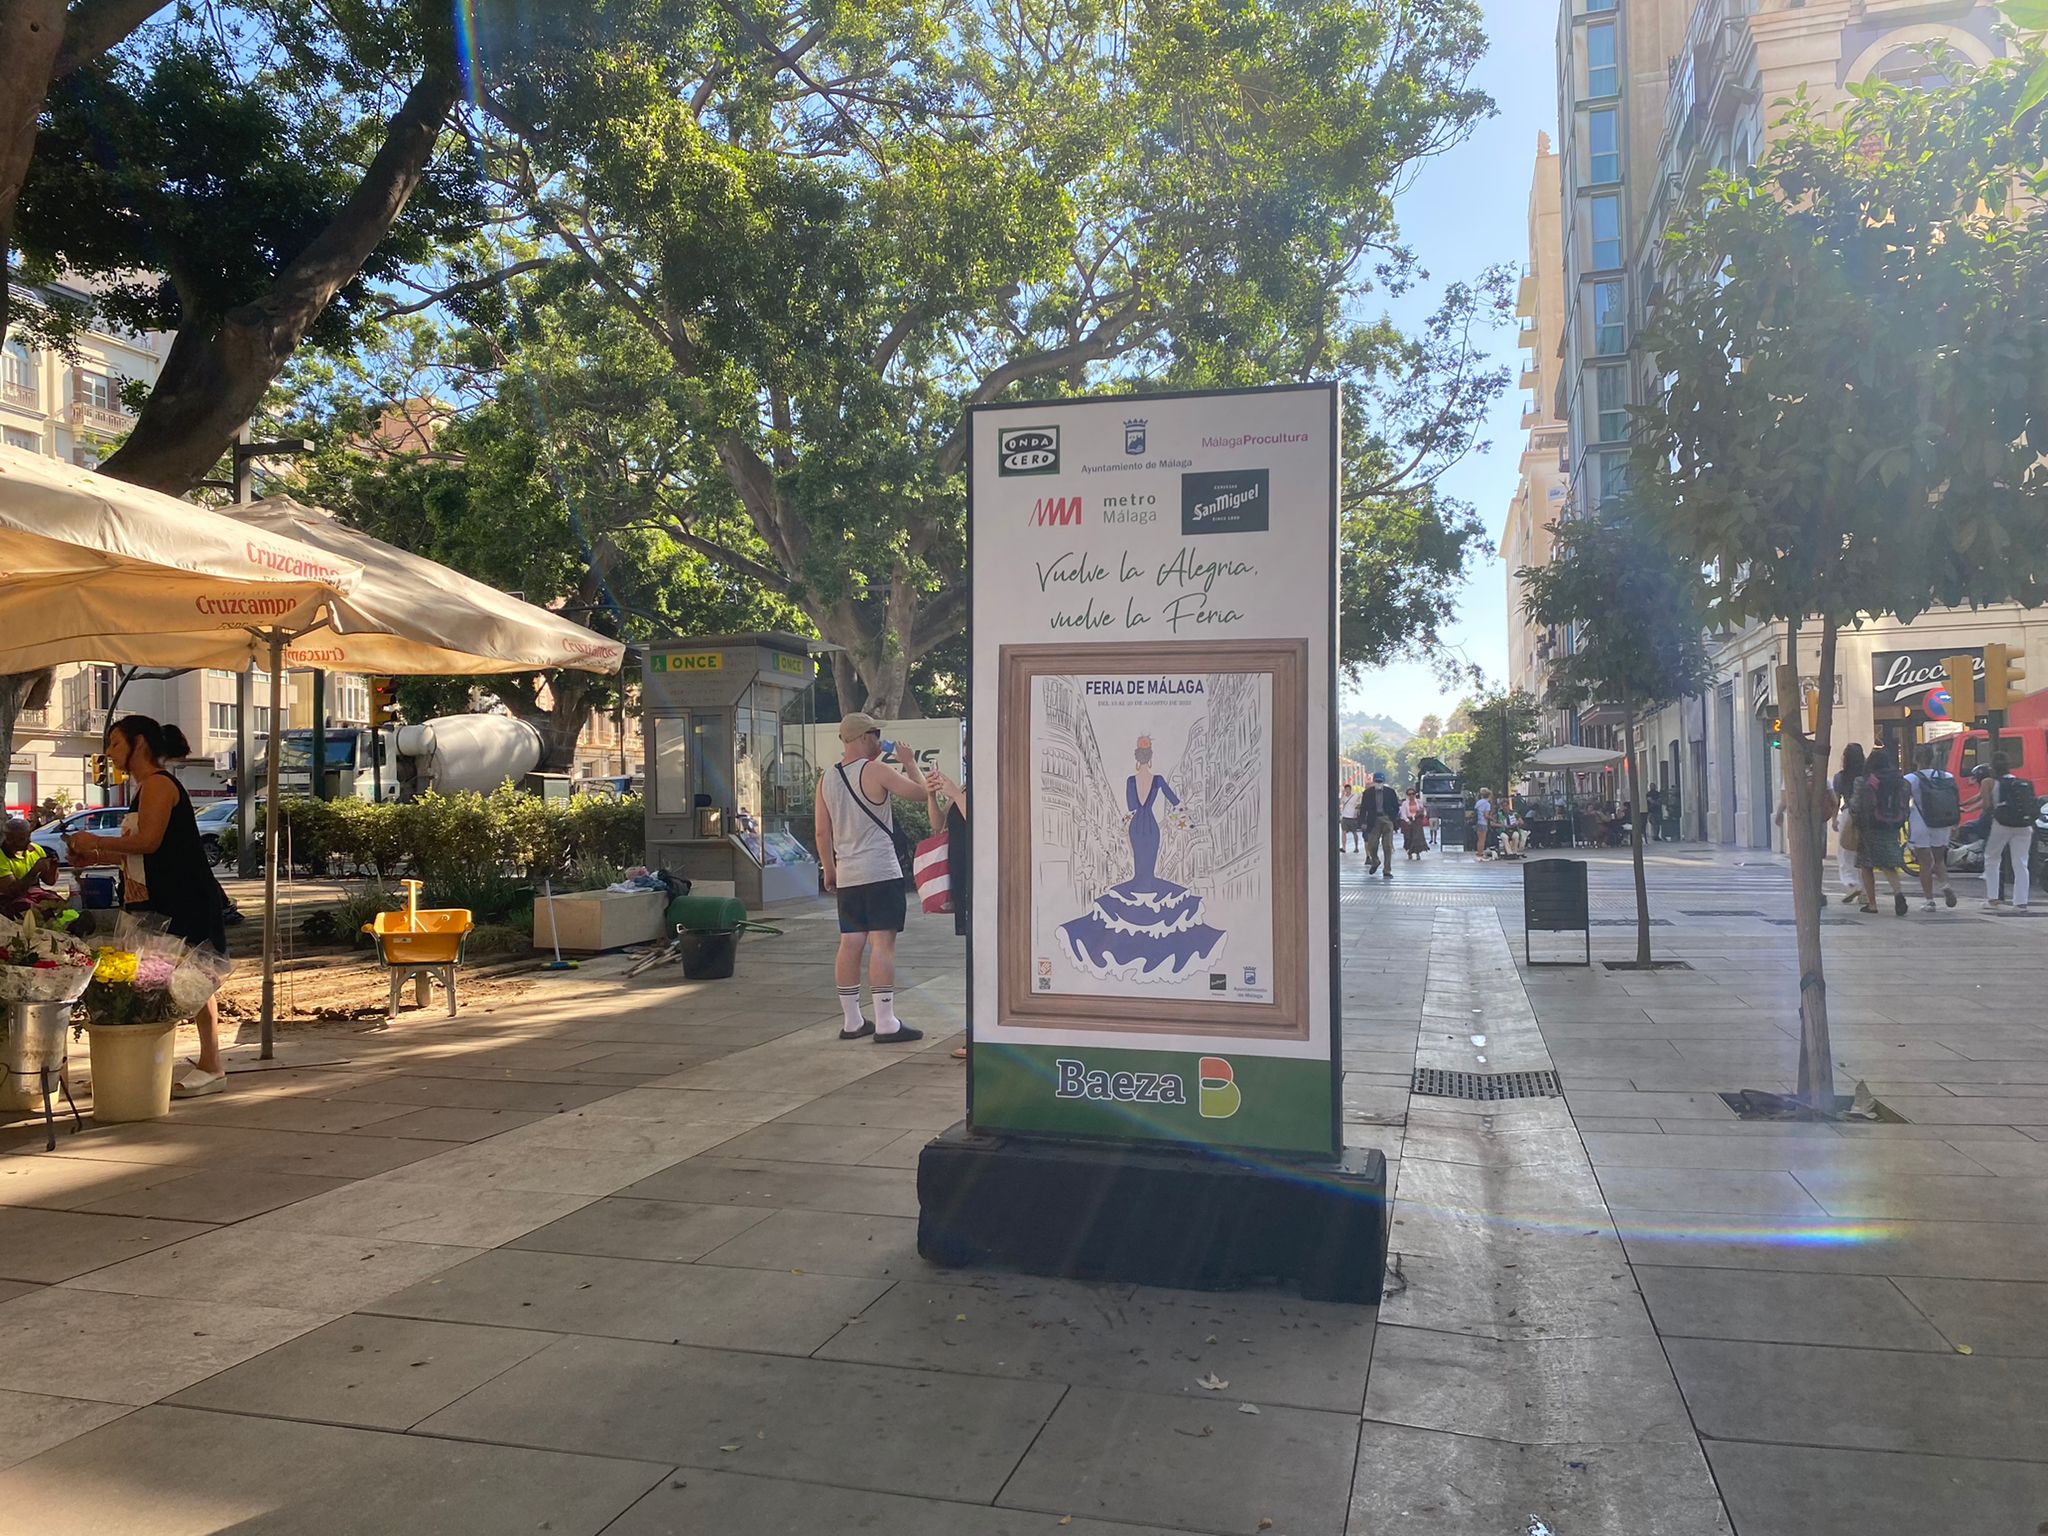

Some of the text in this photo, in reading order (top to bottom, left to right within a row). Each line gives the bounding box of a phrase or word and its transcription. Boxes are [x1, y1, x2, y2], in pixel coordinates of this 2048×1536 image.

[1009, 436, 1050, 449] ONDA
[1201, 431, 1309, 449] MálagaProcultura
[1011, 453, 1050, 467] CERO
[1081, 458, 1193, 474] Ayuntamiento de Málaga
[1103, 493, 1156, 507] metro
[1103, 508, 1157, 525] Málaga
[1036, 551, 1110, 593] Vuelve
[1120, 549, 1145, 583] la
[1050, 592, 1244, 634] vuelve la Feria
[672, 656, 717, 669] ONCE
[781, 657, 802, 669] ONCE
[1086, 676, 1204, 695] FERIA DE MÁLAGA
[1056, 1059, 1186, 1104] Baeza
